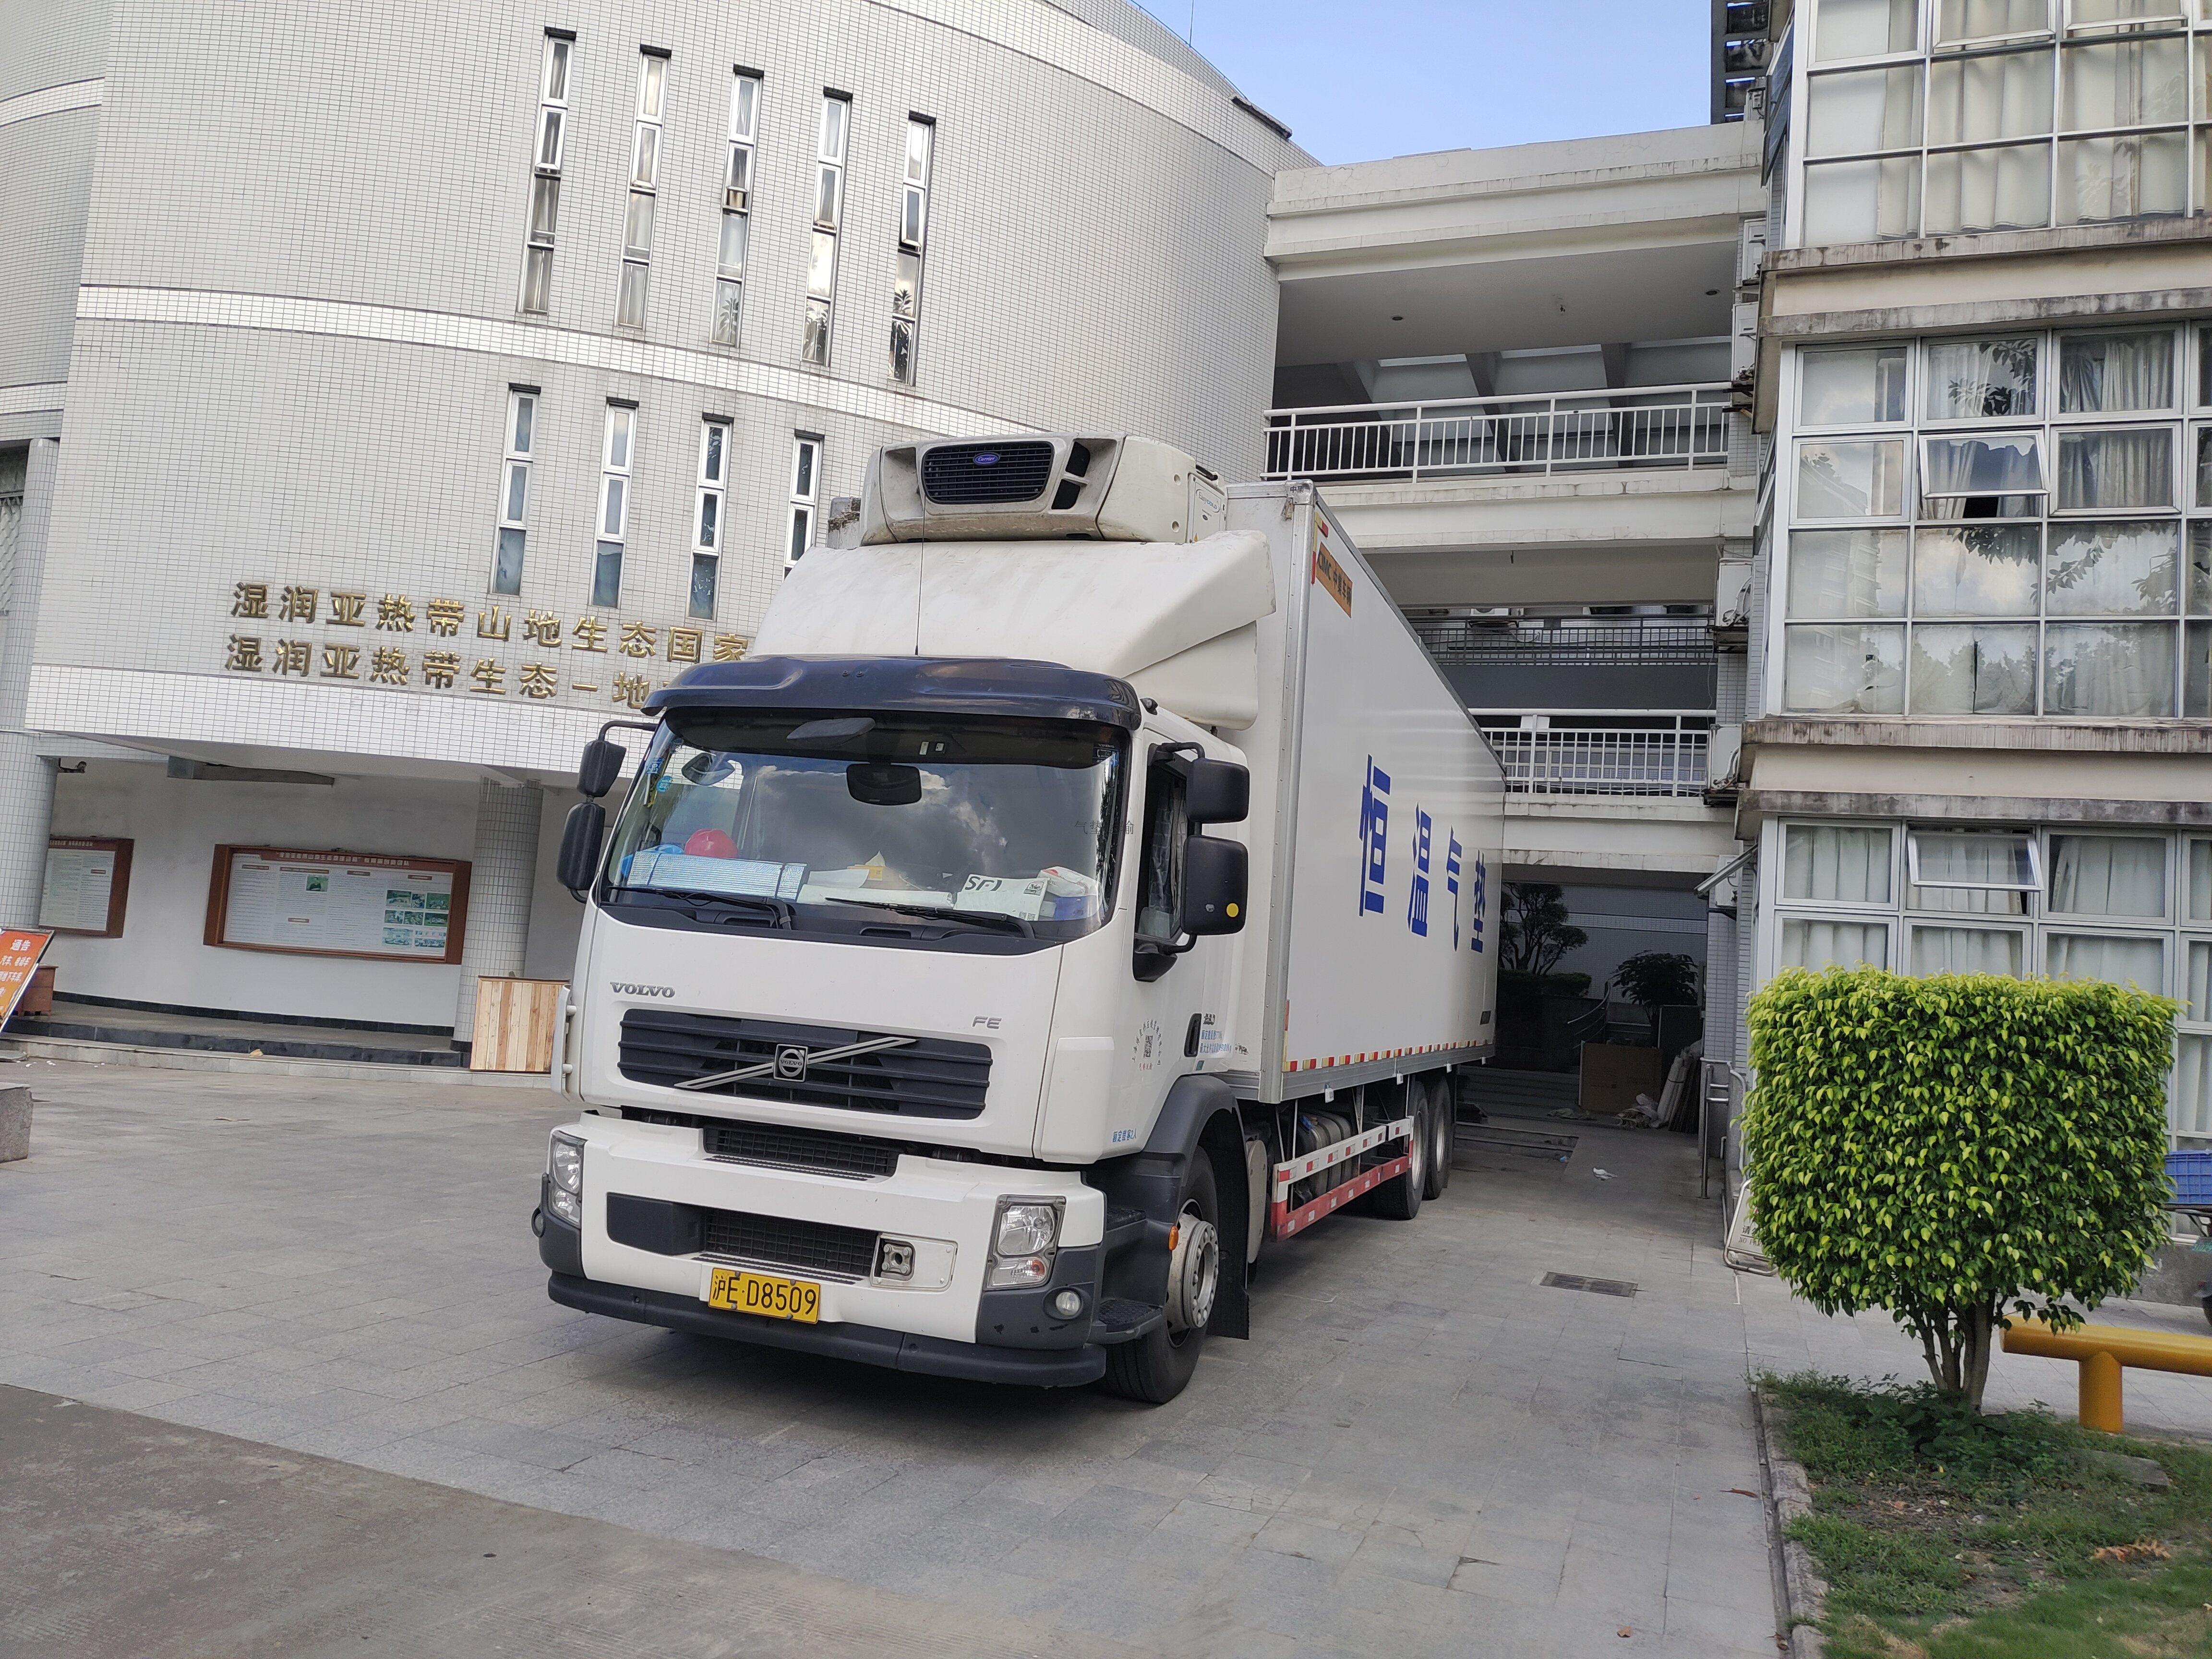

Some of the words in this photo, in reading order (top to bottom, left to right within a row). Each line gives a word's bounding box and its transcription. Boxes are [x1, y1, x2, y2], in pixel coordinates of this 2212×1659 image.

[231, 582, 748, 662] 湿润亚热带山地生态国家
[10, 939, 31, 951] 通告
[610, 981, 675, 998] VOLVO
[972, 1016, 1002, 1029] FE
